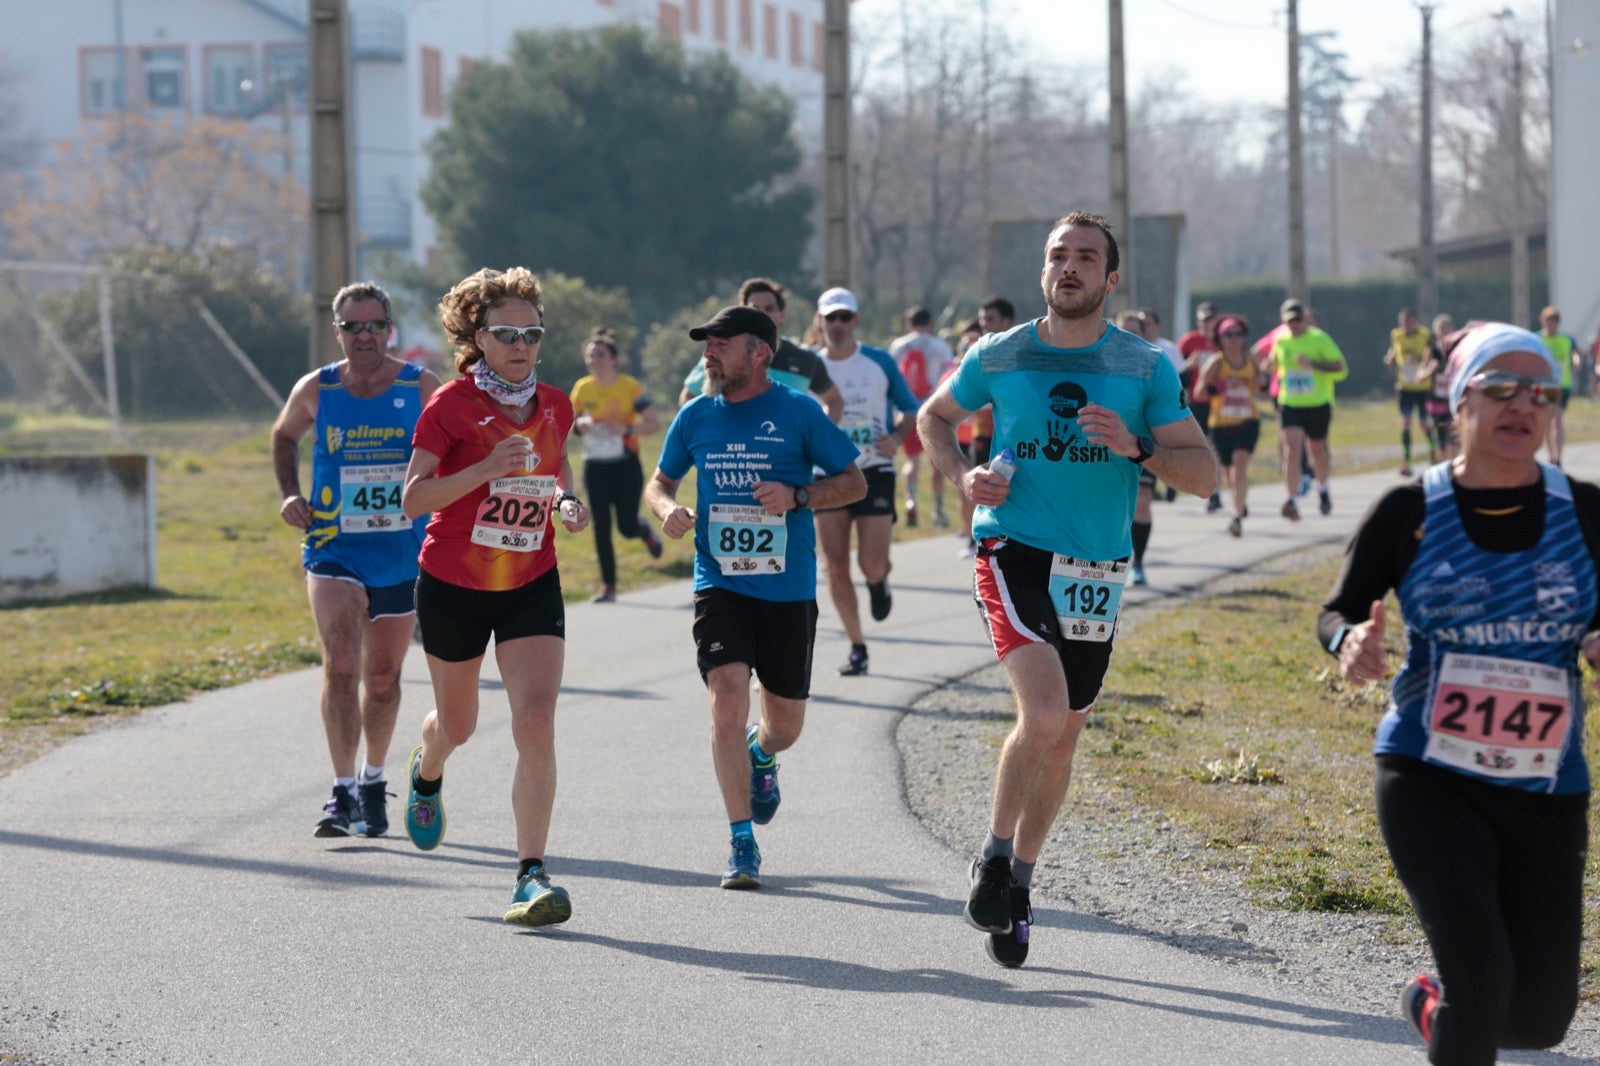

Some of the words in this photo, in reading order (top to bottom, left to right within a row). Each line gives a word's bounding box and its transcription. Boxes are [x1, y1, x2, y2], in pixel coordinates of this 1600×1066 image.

[347, 425, 405, 440] olimpo
[345, 440, 382, 448] deportes
[726, 443, 746, 452] XIII
[344, 453, 364, 461] TRAIL
[373, 452, 405, 460] RUNNING
[736, 452, 769, 460] Popular
[353, 484, 404, 510] 454
[719, 527, 773, 553] 892
[1064, 583, 1110, 616] 192
[1439, 691, 1564, 742] 2147
